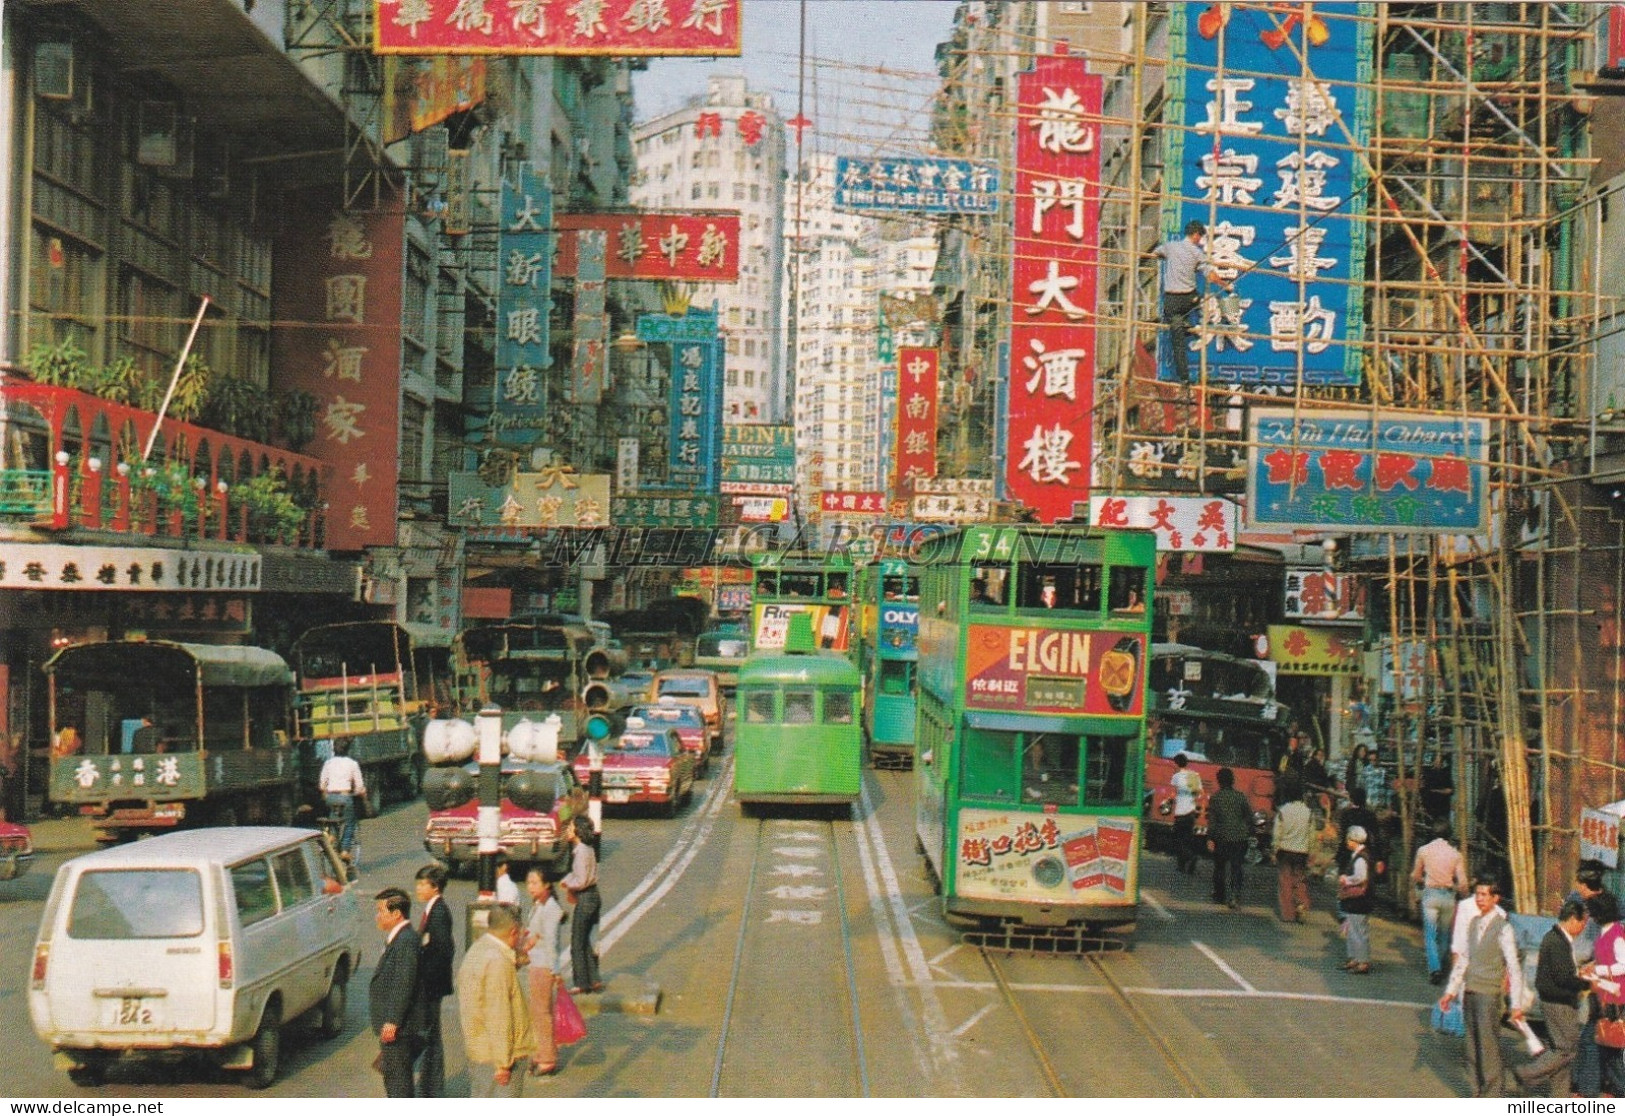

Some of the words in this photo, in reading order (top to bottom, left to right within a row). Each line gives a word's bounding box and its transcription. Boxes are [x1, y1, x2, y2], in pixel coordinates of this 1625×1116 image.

[616, 221, 728, 269] 新中華
[504, 194, 545, 402] 大新眼鏡
[1018, 86, 1095, 485] 龍門大酒樓
[976, 533, 1010, 556] 34
[884, 610, 918, 624] OLY
[1009, 629, 1091, 674] ELGIN
